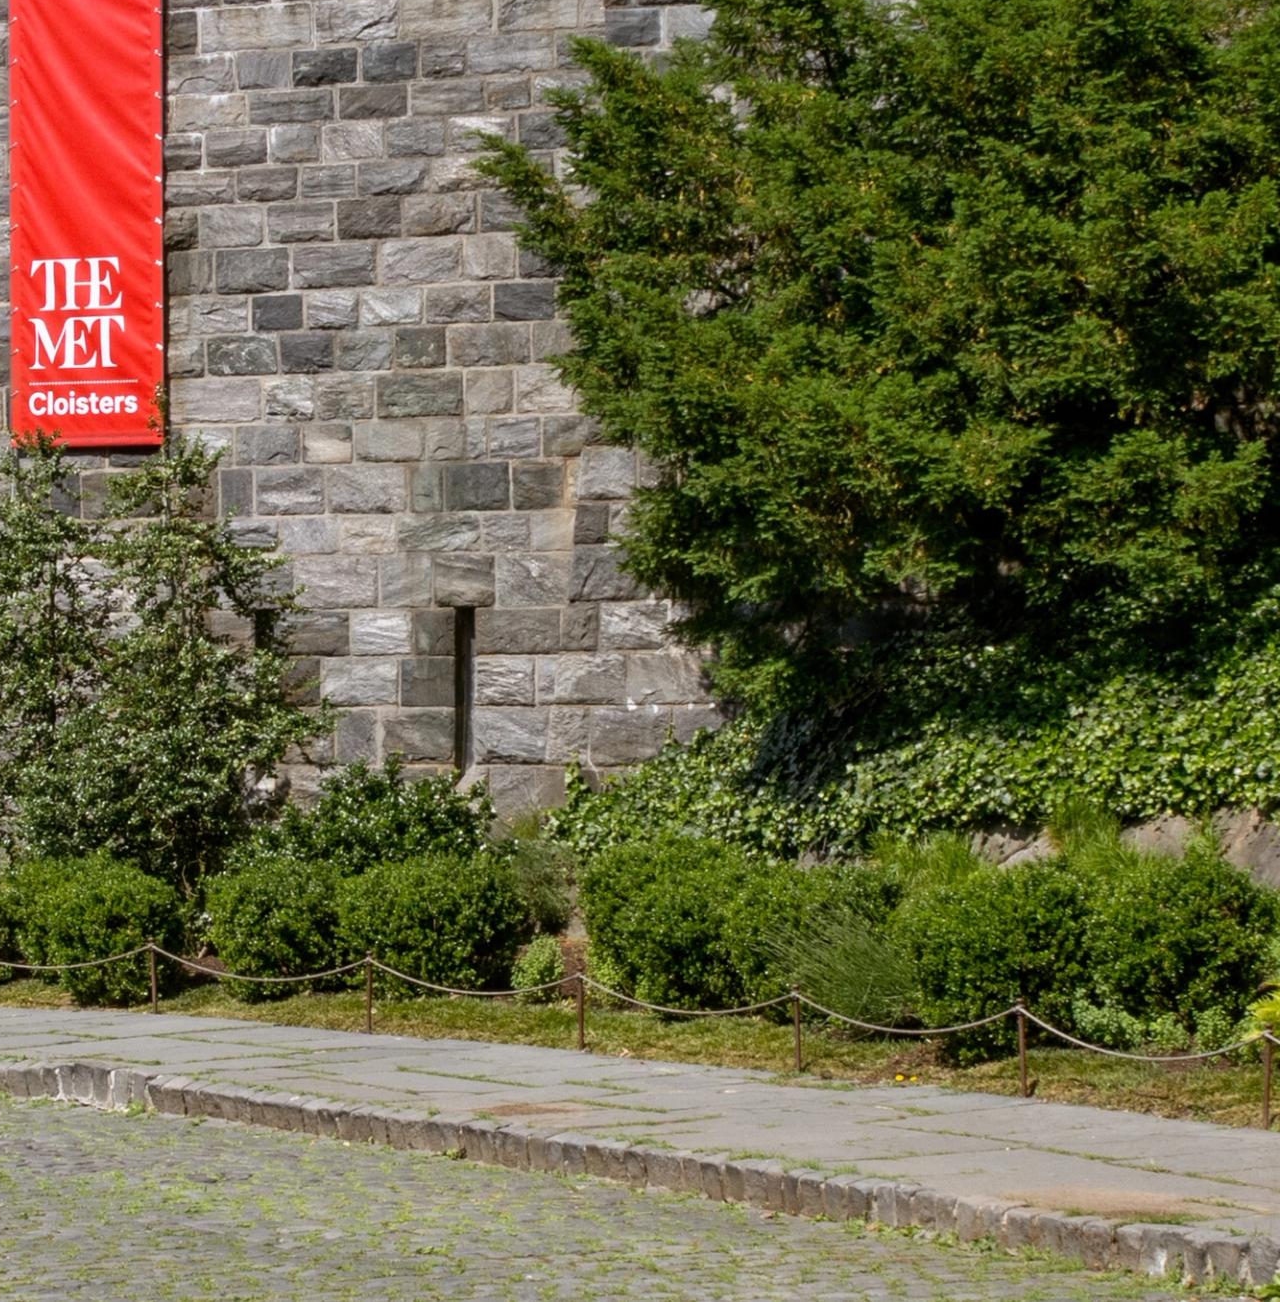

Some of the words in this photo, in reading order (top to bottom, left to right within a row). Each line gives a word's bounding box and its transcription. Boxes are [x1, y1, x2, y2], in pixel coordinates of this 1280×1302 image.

[30, 257, 123, 311] THE
[29, 315, 125, 370] MET
[28, 390, 139, 417] Cloisters
